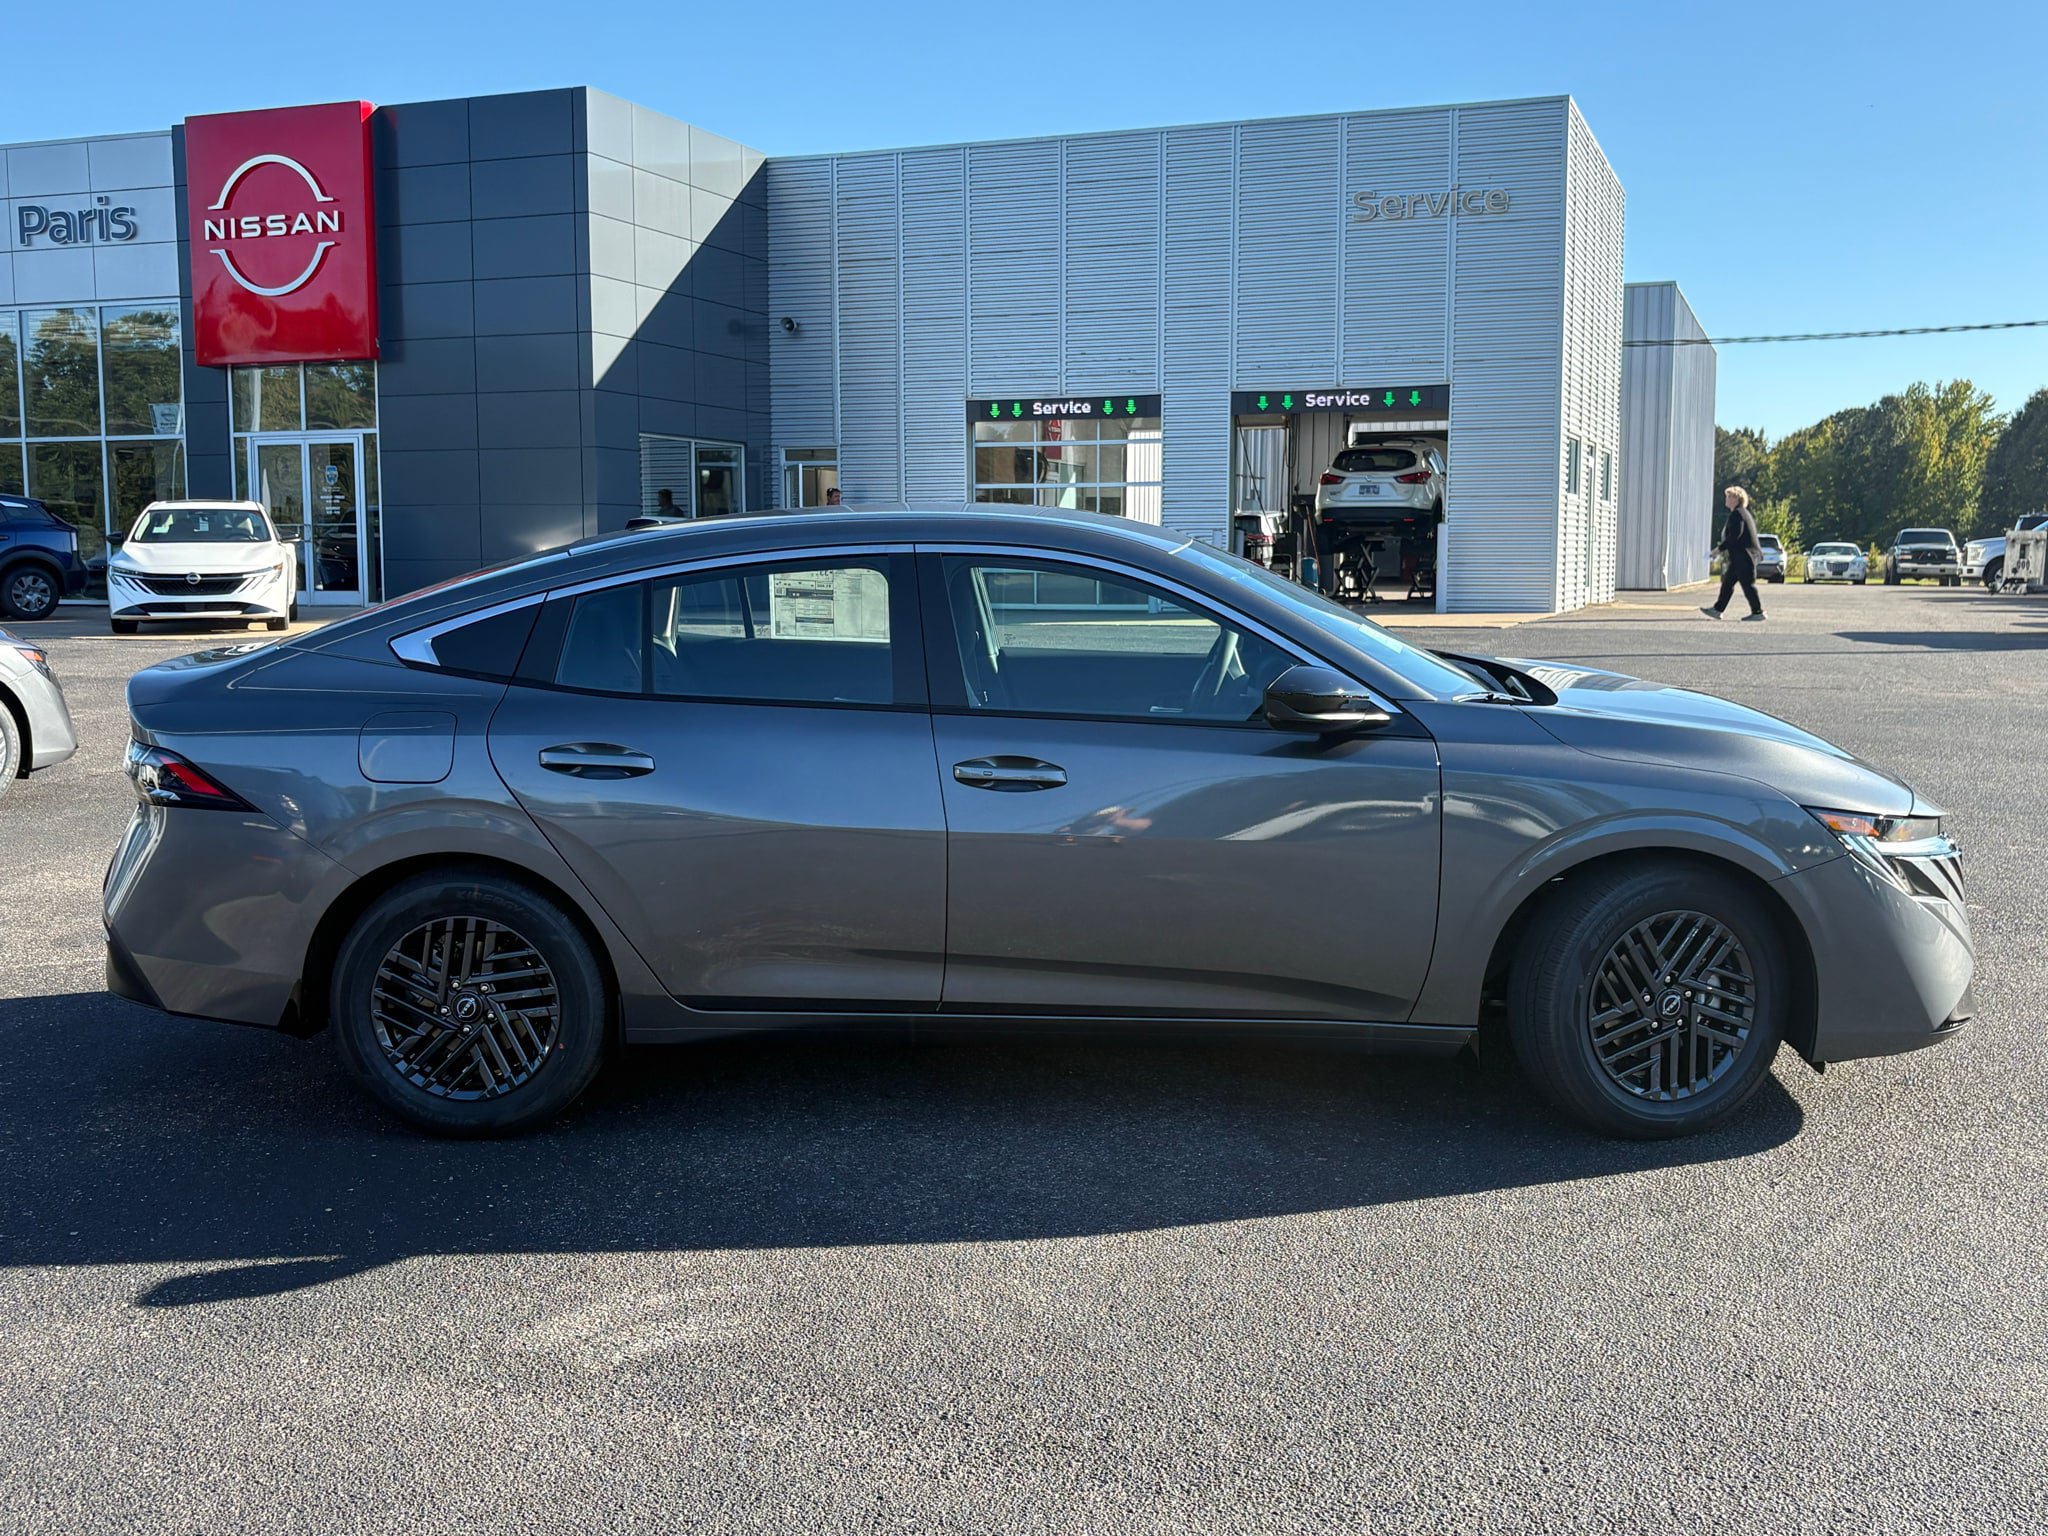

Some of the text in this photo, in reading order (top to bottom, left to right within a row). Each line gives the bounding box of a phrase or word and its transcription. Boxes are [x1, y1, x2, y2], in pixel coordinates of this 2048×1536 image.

[1352, 183, 1510, 222] Service
[18, 196, 136, 246] Paris
[204, 210, 339, 241] NISSAN
[1032, 401, 1092, 415] Service
[1305, 391, 1370, 407] Service
